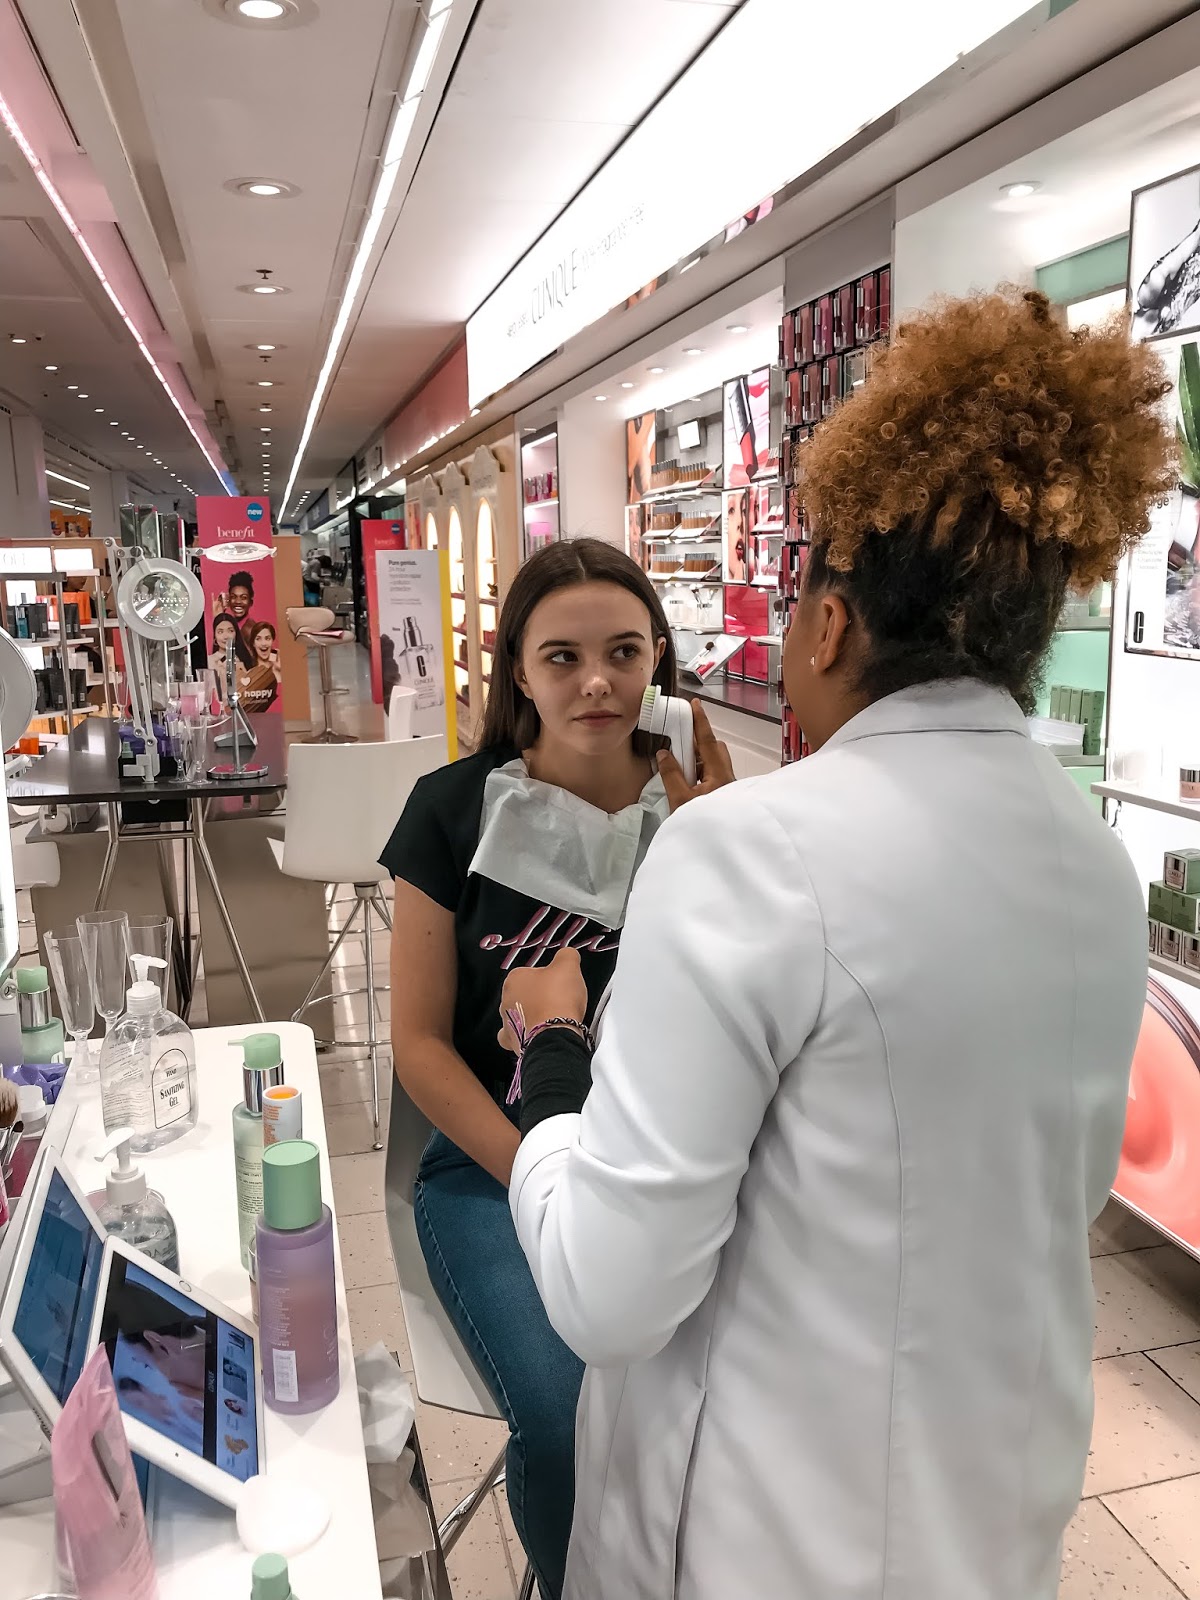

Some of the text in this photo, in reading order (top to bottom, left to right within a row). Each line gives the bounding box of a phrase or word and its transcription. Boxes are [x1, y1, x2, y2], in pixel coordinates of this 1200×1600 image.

[531, 248, 578, 325] CLINIQUE
[217, 526, 255, 540] benefit
[244, 689, 273, 698] happy
